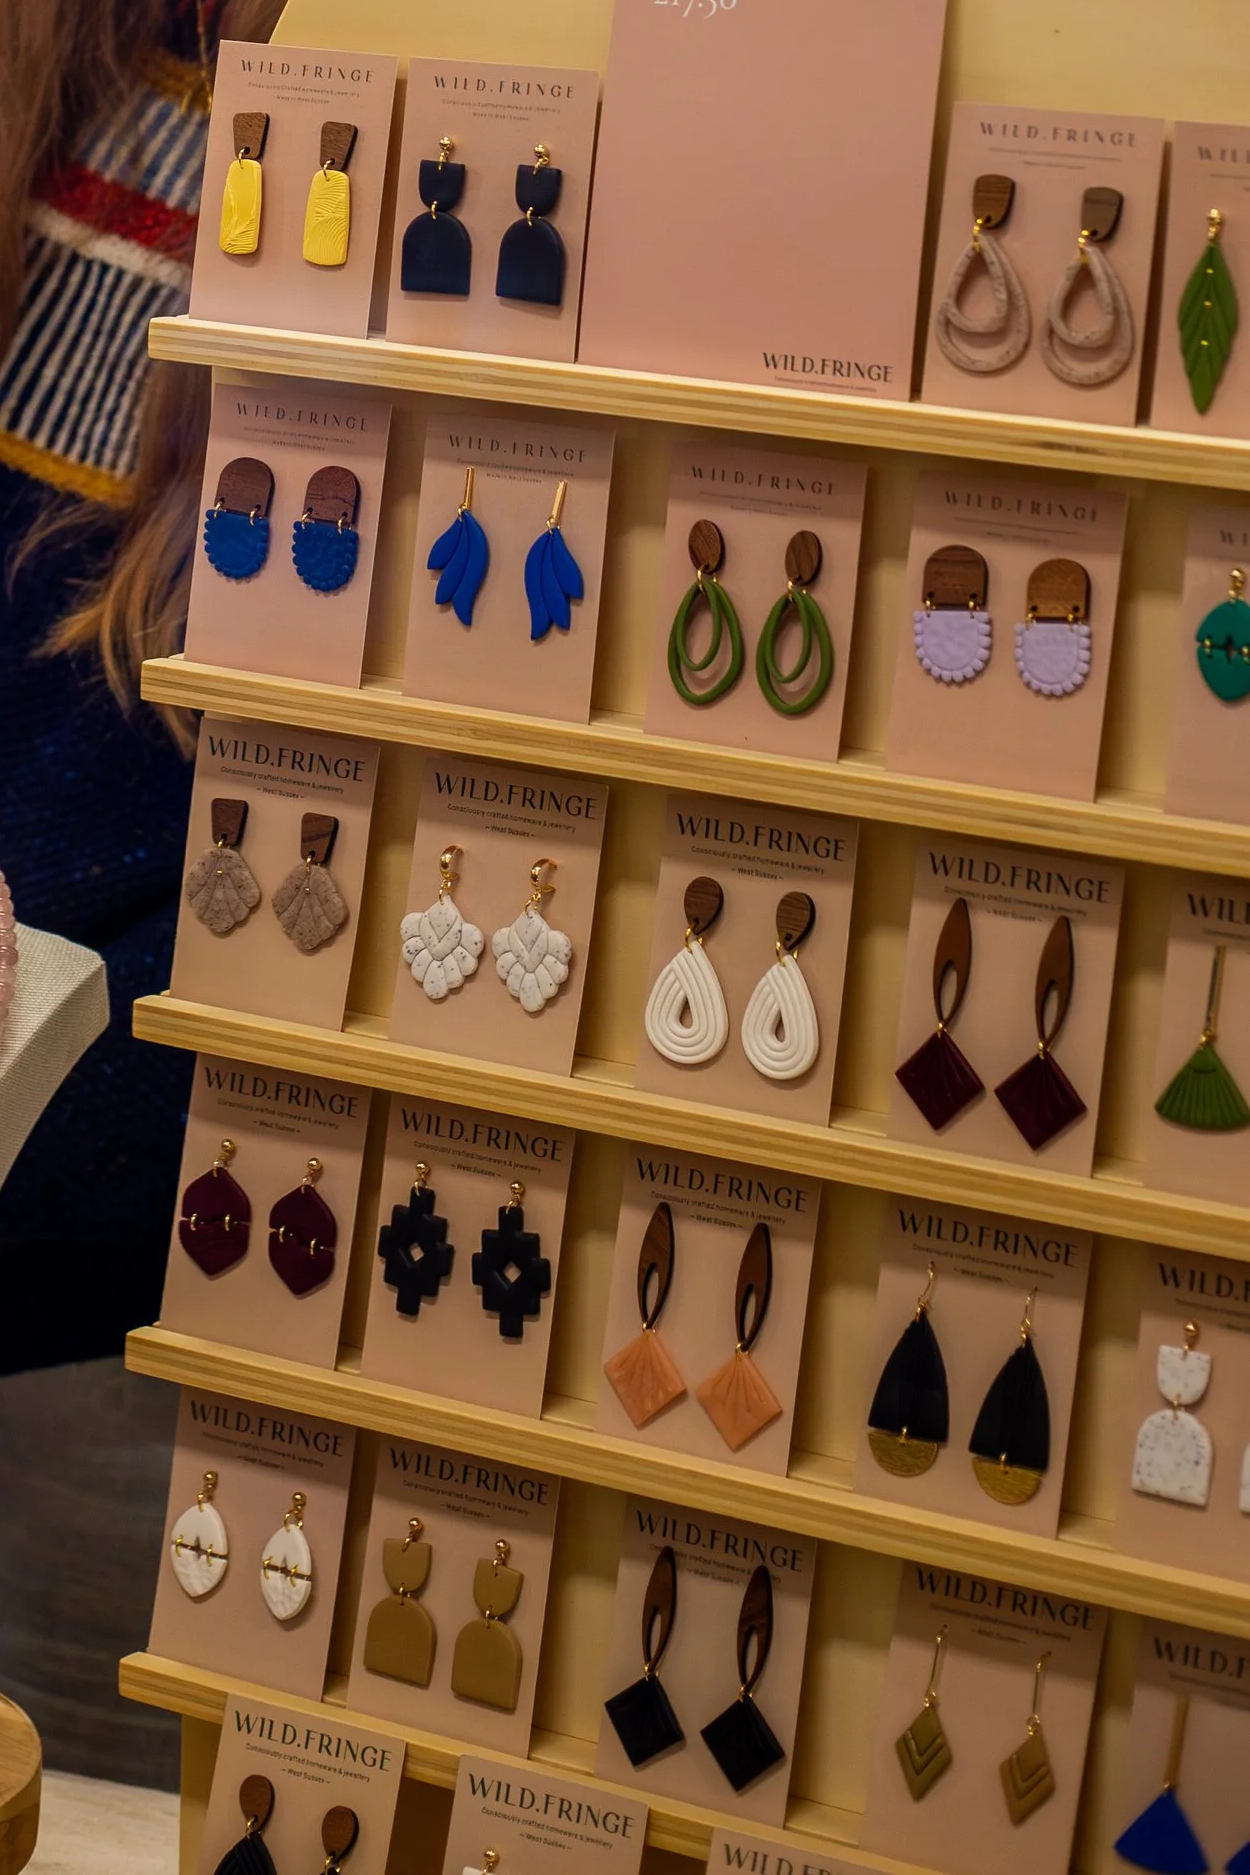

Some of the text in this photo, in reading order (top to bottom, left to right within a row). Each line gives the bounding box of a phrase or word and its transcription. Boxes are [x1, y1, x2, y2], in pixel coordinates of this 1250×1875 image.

[242, 59, 375, 83] WILD.FRINGE
[434, 76, 574, 99] WILD.FRINGE
[980, 122, 1138, 147] WILD.FRINGE
[762, 352, 894, 383] WILD.FRINGE
[237, 403, 366, 431] WILD.FRINGE
[450, 435, 586, 463] WILD.FRINGE
[692, 466, 836, 495] WILD.FRINGE
[208, 735, 366, 781] WILD.FRINGE
[435, 773, 598, 820] WILD.FRINGE
[676, 813, 846, 861] WILD.FRINGE
[929, 851, 1110, 903] WILD.FRINGE
[205, 1067, 358, 1118] WILD.FRINGE
[402, 1109, 565, 1162] WILD.FRINGE
[636, 1157, 808, 1213] WILD.FRINGE
[898, 1209, 1079, 1267] WILD.FRINGE
[190, 1400, 344, 1457] WILD.FRINGE
[390, 1447, 549, 1507] WILD.FRINGE
[636, 1509, 804, 1573] WILD.FRINGE
[916, 1567, 1094, 1631] WILD.FRINGE
[234, 1710, 393, 1772] WILD.FRINGE
[468, 1773, 636, 1839] WILD.FRINGE
